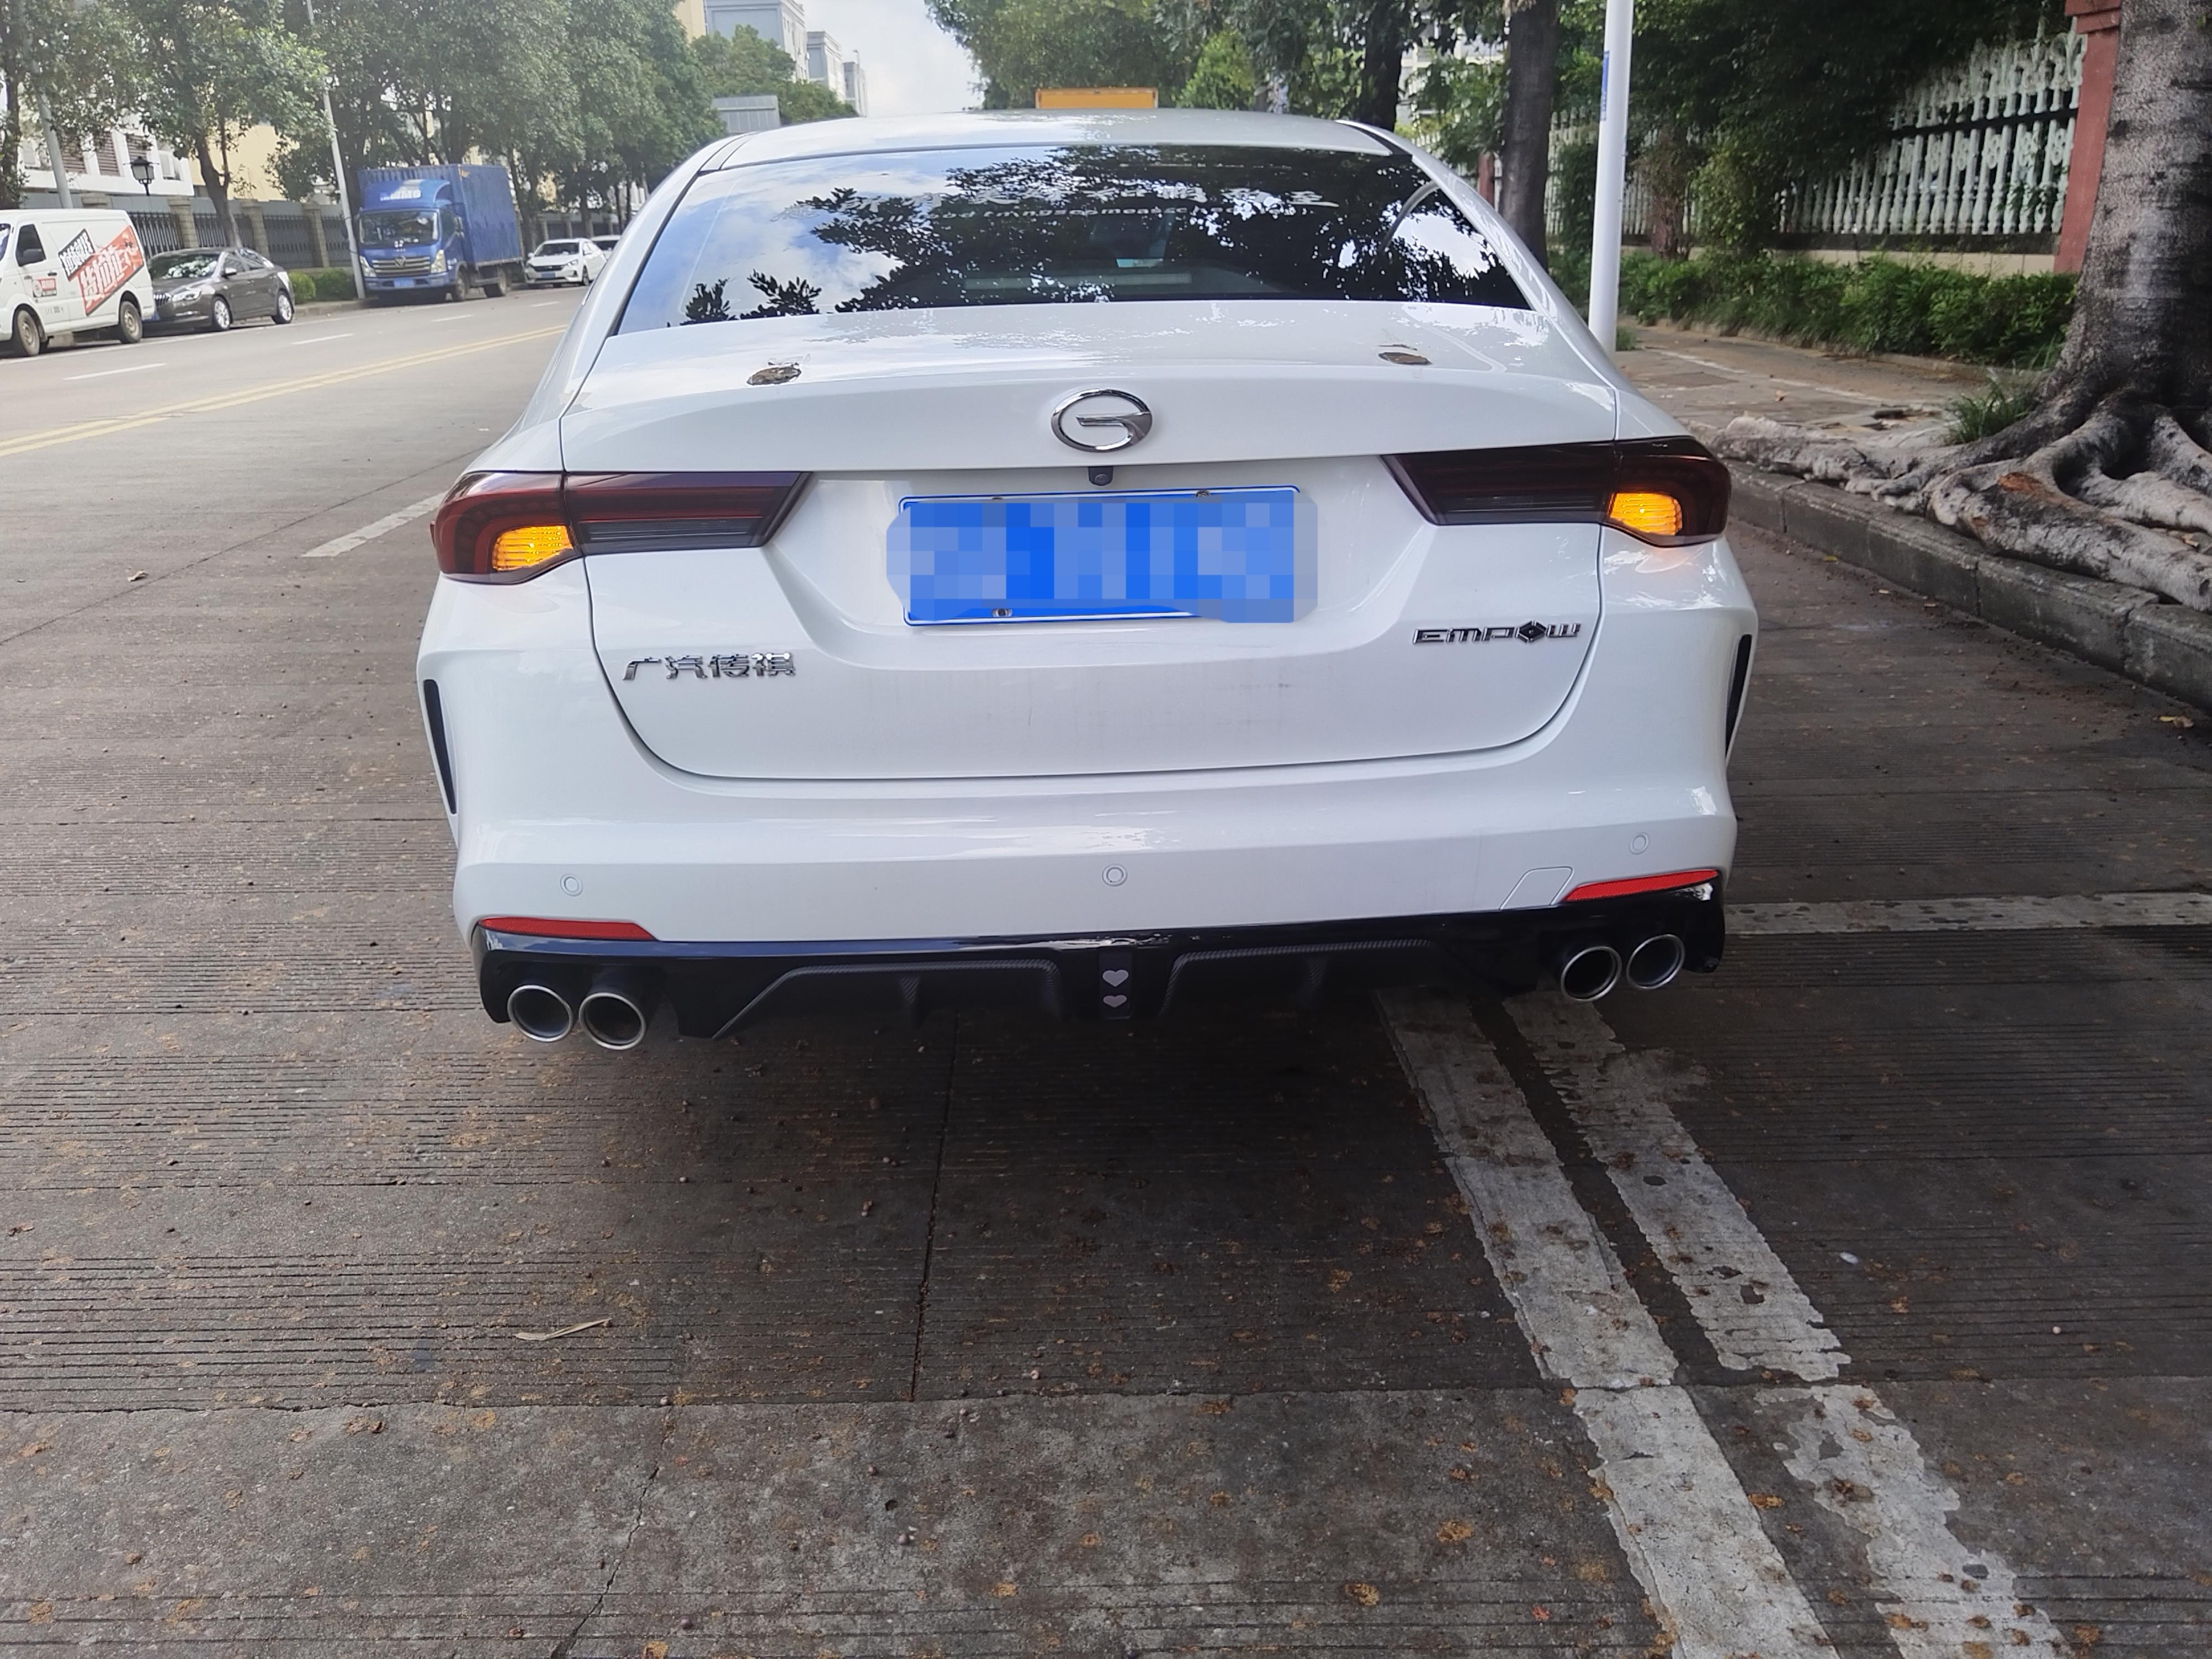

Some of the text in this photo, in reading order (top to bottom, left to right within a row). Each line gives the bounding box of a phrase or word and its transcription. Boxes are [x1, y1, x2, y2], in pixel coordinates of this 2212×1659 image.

[1412, 619, 1581, 644] EMPOW
[622, 652, 796, 681] 广汽传祺
